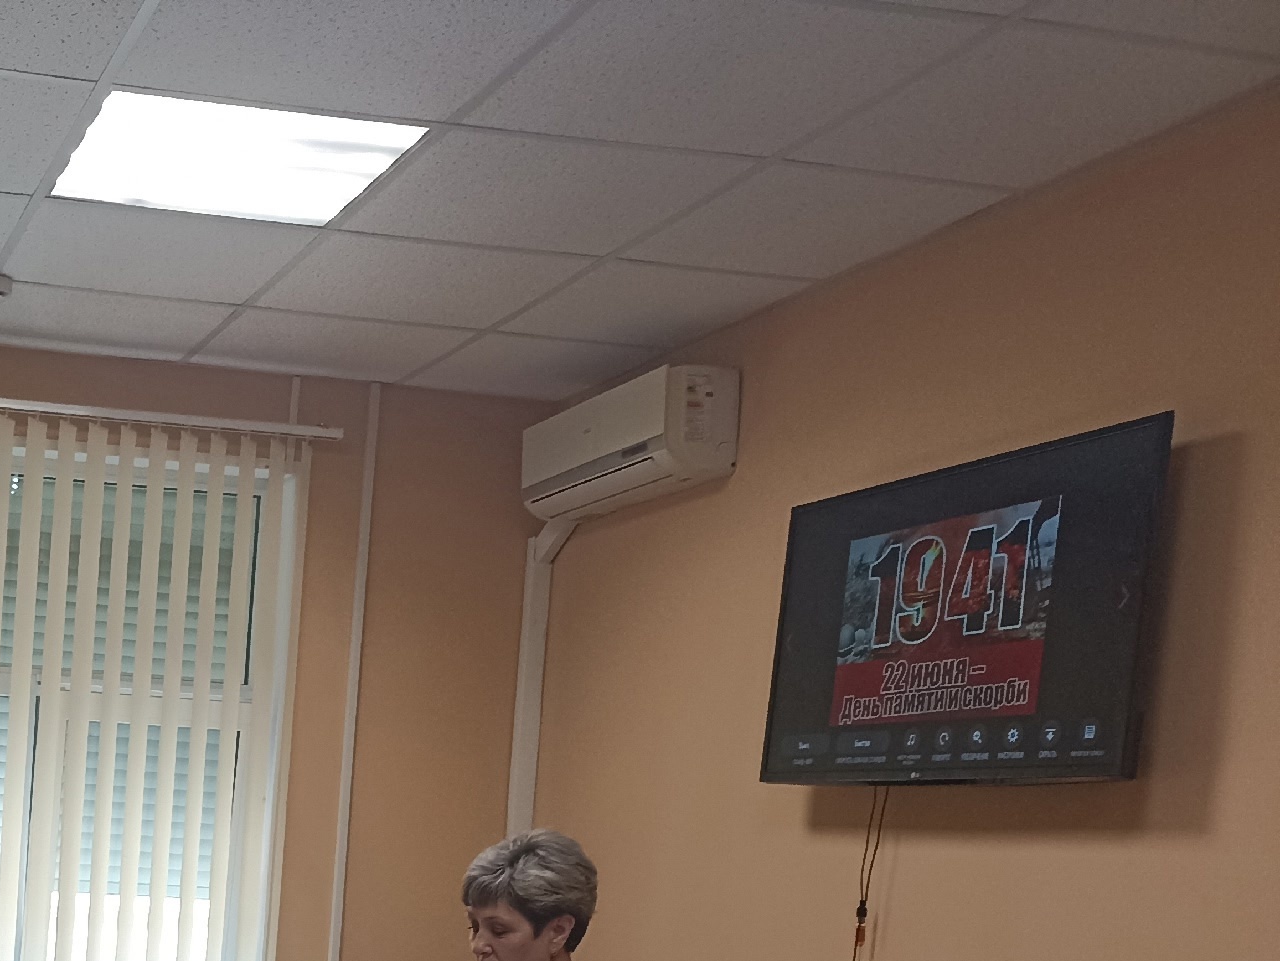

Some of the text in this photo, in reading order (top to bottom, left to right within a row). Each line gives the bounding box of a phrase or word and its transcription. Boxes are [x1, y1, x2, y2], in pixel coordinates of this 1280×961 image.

[868, 516, 1033, 650] 1941
[880, 660, 908, 694] 22
[838, 678, 1030, 726] День памяти и скорби
